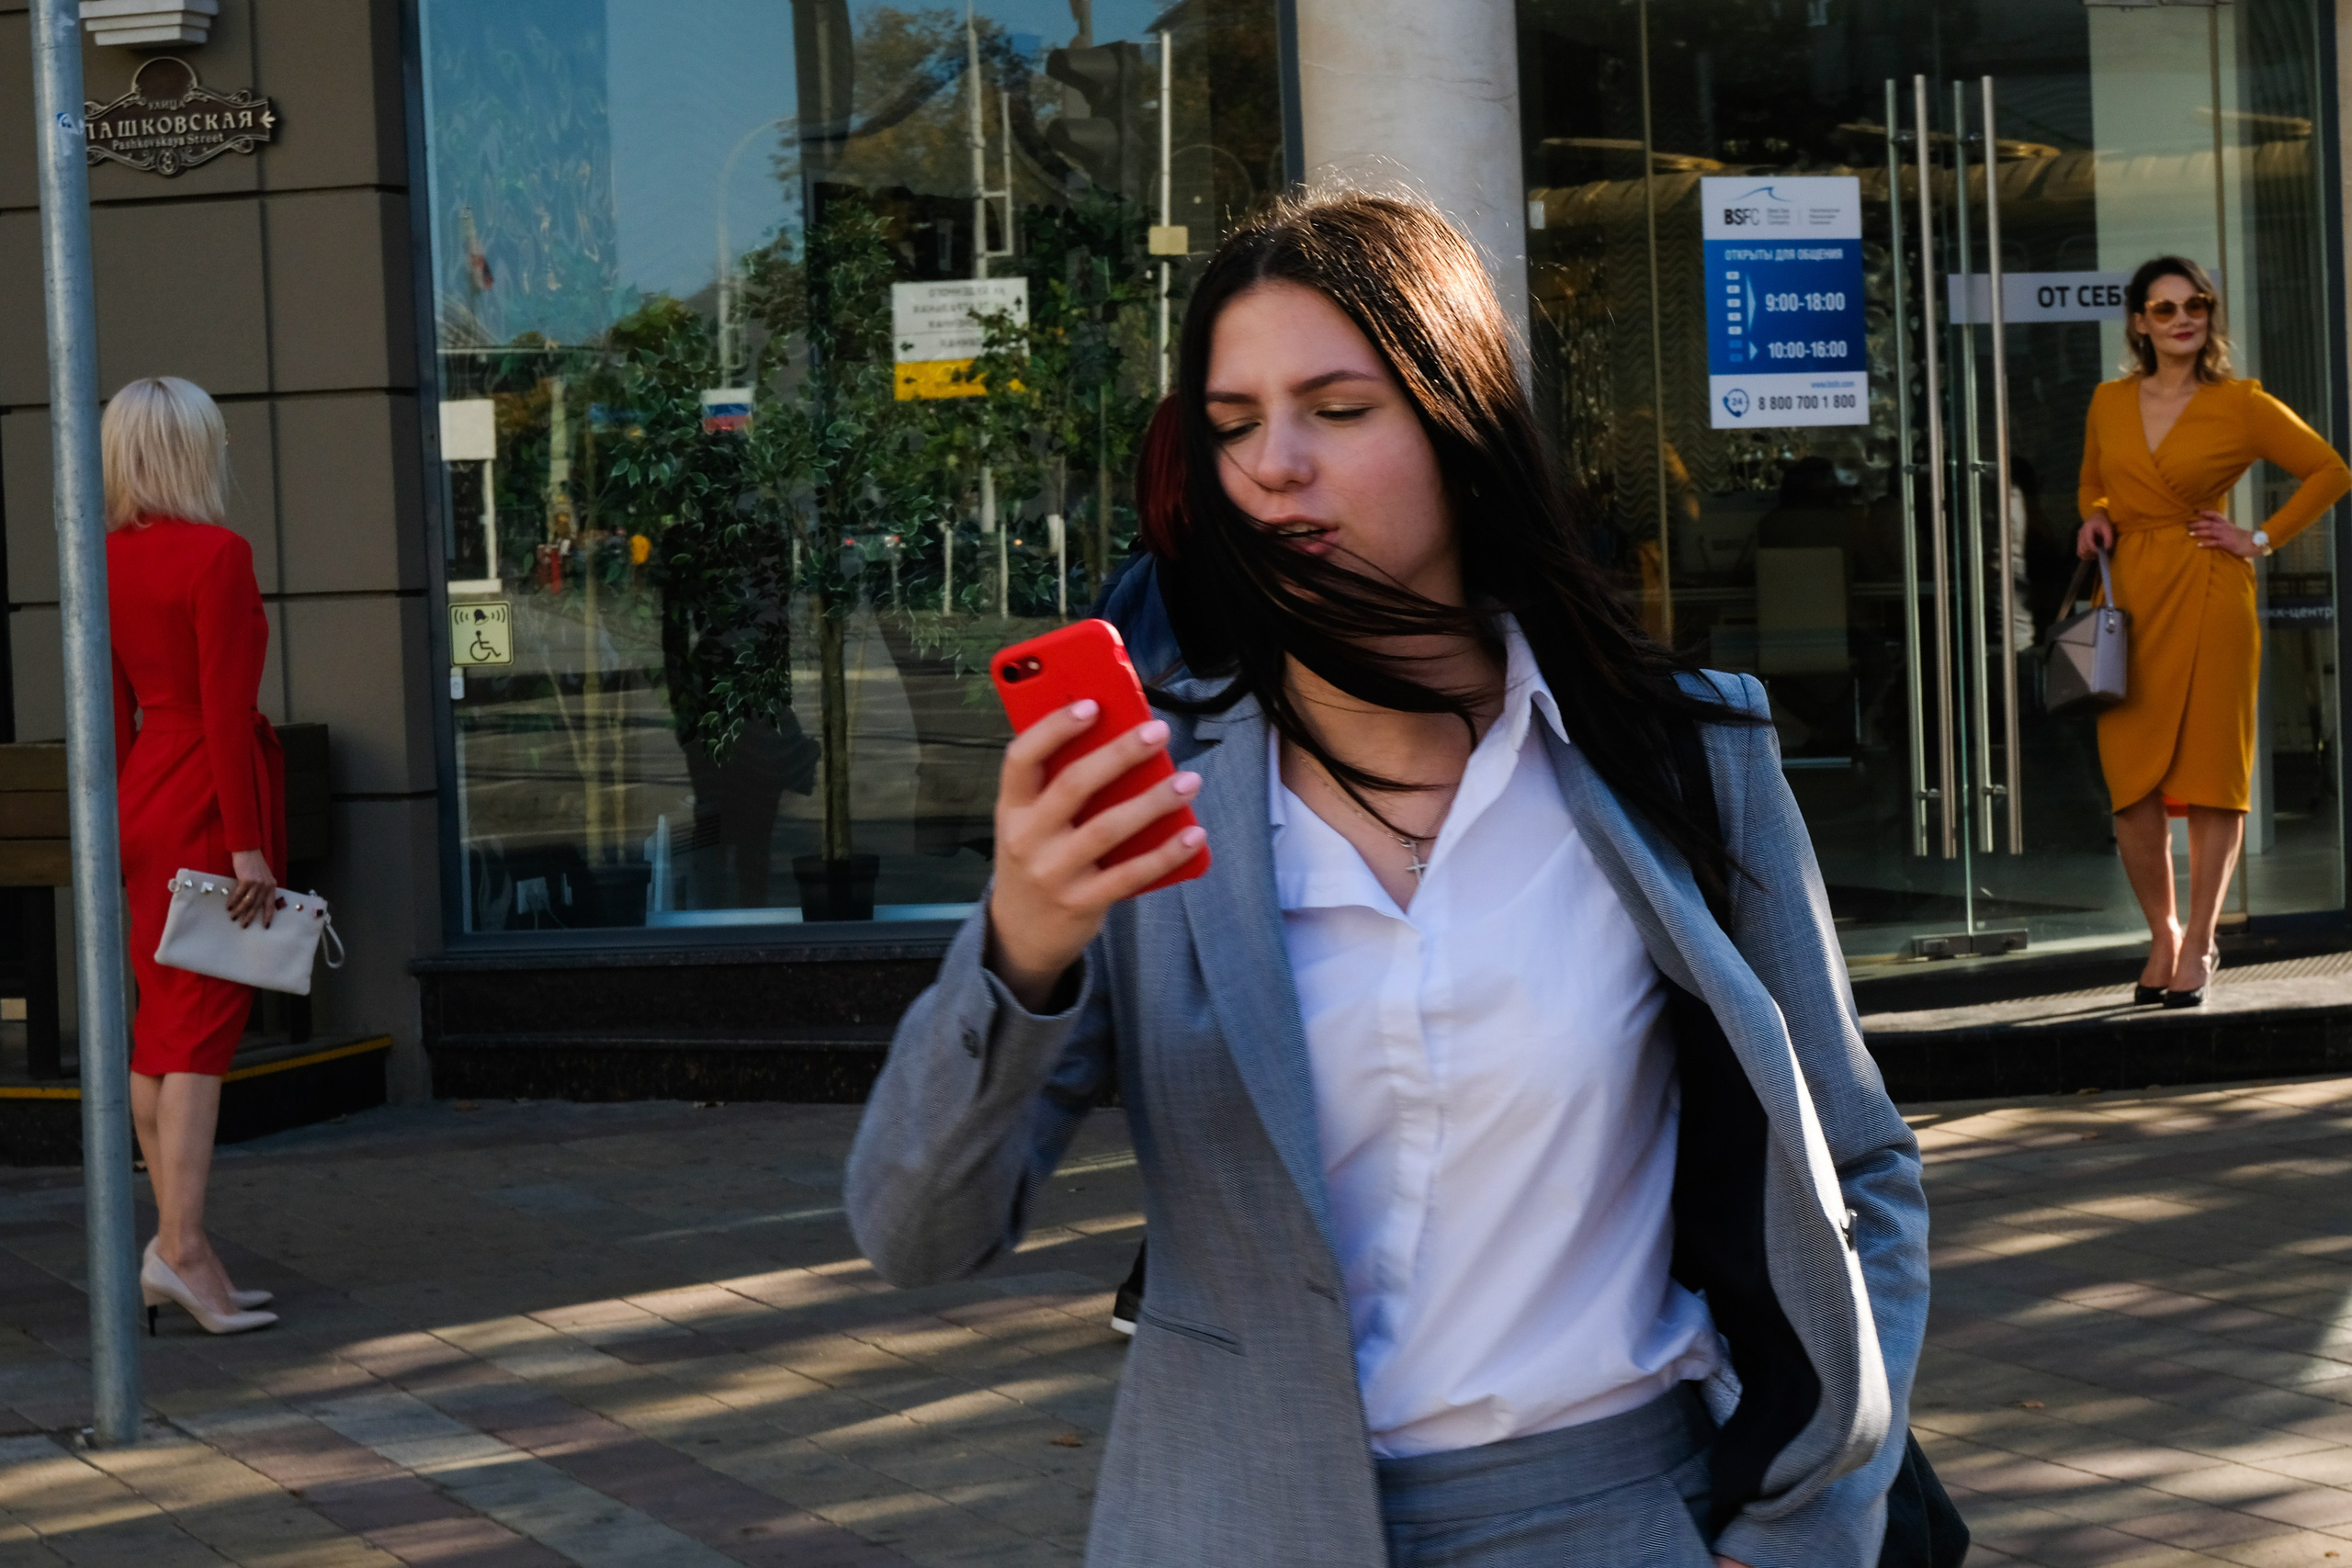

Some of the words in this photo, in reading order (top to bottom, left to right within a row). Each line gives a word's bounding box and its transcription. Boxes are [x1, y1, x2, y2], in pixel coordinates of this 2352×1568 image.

[148, 100, 185, 110] УЛИЦА
[112, 136, 185, 151] Pashkovskaya
[187, 133, 223, 145] Street
[1724, 208, 1760, 226] BSFC
[1724, 249, 1773, 261] ОТКРЫТЫ
[1774, 248, 1795, 262] ДЛЯ
[1797, 248, 1843, 261] ОБЩЕНИЯ
[1765, 292, 1846, 312] 9:00-18:00
[2037, 286, 2071, 308] ОТ
[2077, 285, 2128, 308] СЕБ
[1768, 341, 1848, 358] 10:00-16:00
[1758, 397, 1766, 411] 8
[1770, 396, 1792, 411] 800
[1796, 395, 1819, 410] 700
[1822, 396, 1828, 409] 1
[1833, 394, 1856, 409] 800
